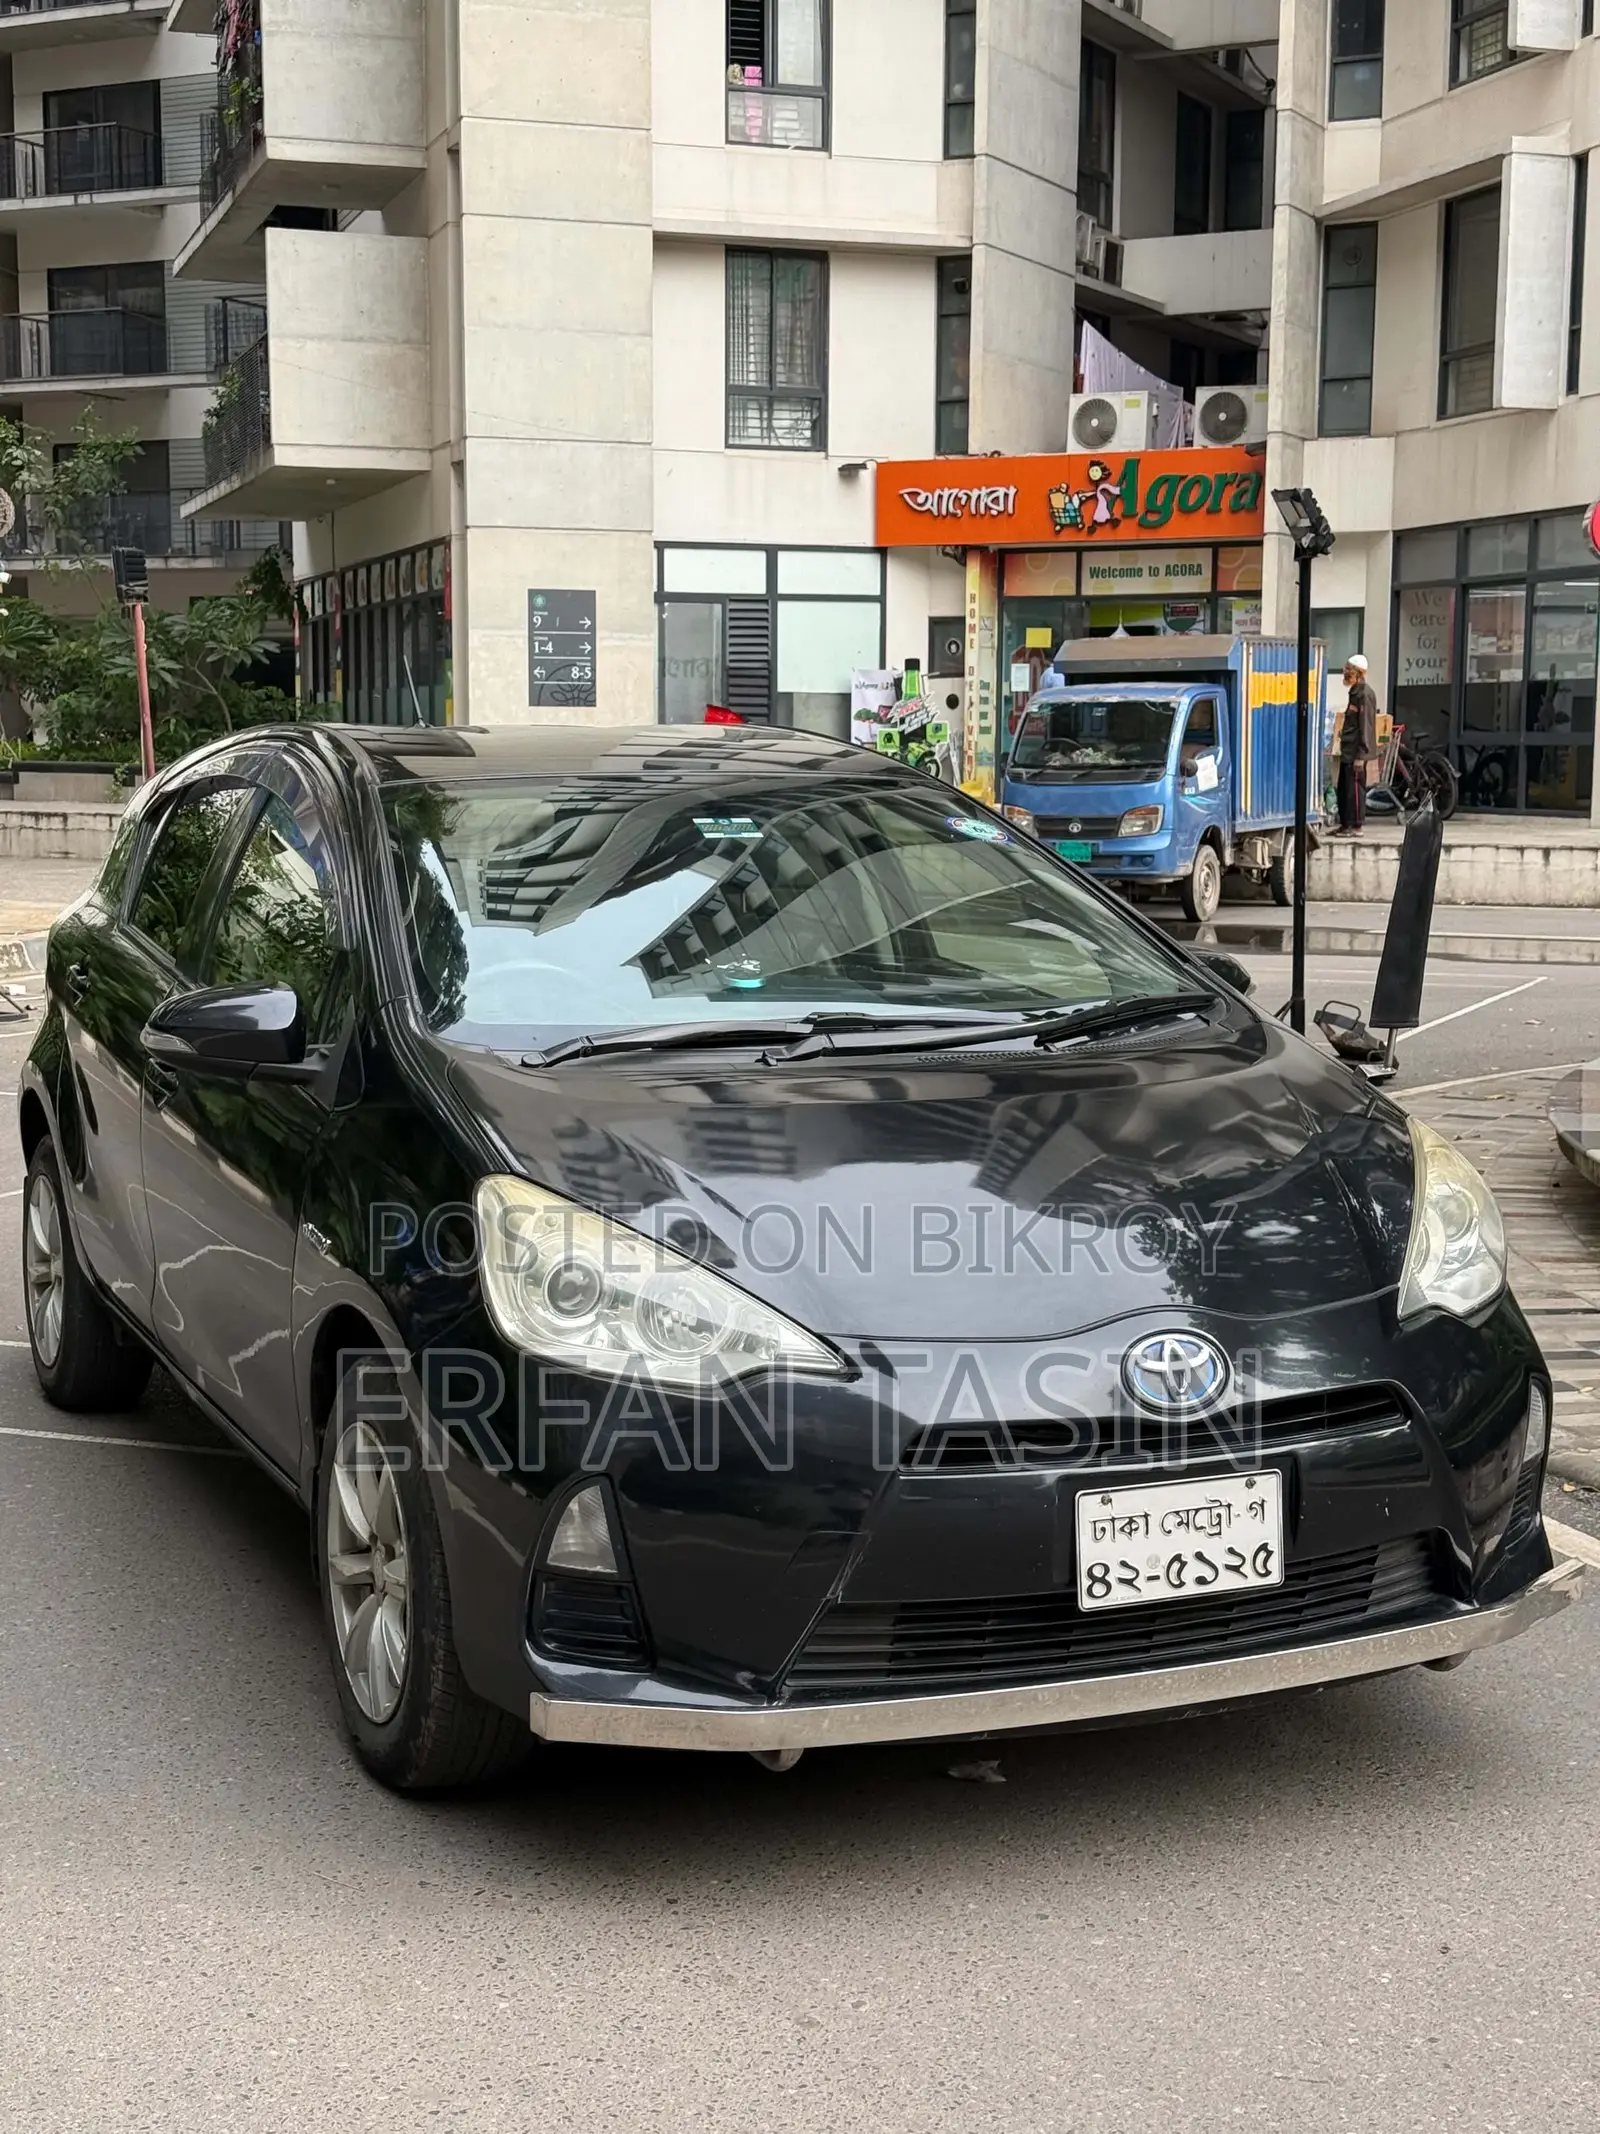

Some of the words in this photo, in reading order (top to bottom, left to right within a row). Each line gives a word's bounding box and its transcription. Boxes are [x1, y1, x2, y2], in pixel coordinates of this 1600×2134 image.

[1112, 457, 1263, 529] Agora
[898, 485, 1018, 519] আগোরা
[1088, 565, 1144, 580] Welcome
[1148, 565, 1161, 578] to
[1164, 563, 1204, 578] AGORA
[1413, 590, 1443, 608] We
[532, 615, 542, 629] 9
[968, 592, 977, 650] HOME
[1409, 612, 1448, 627] care
[533, 640, 554, 654] 1-4
[1415, 633, 1441, 650] for
[1404, 655, 1448, 672] your
[570, 666, 592, 679] 8-5
[1089, 1510, 1152, 1543] ঢাকা
[1085, 1541, 1276, 1600] ৪২-৫১২৫
